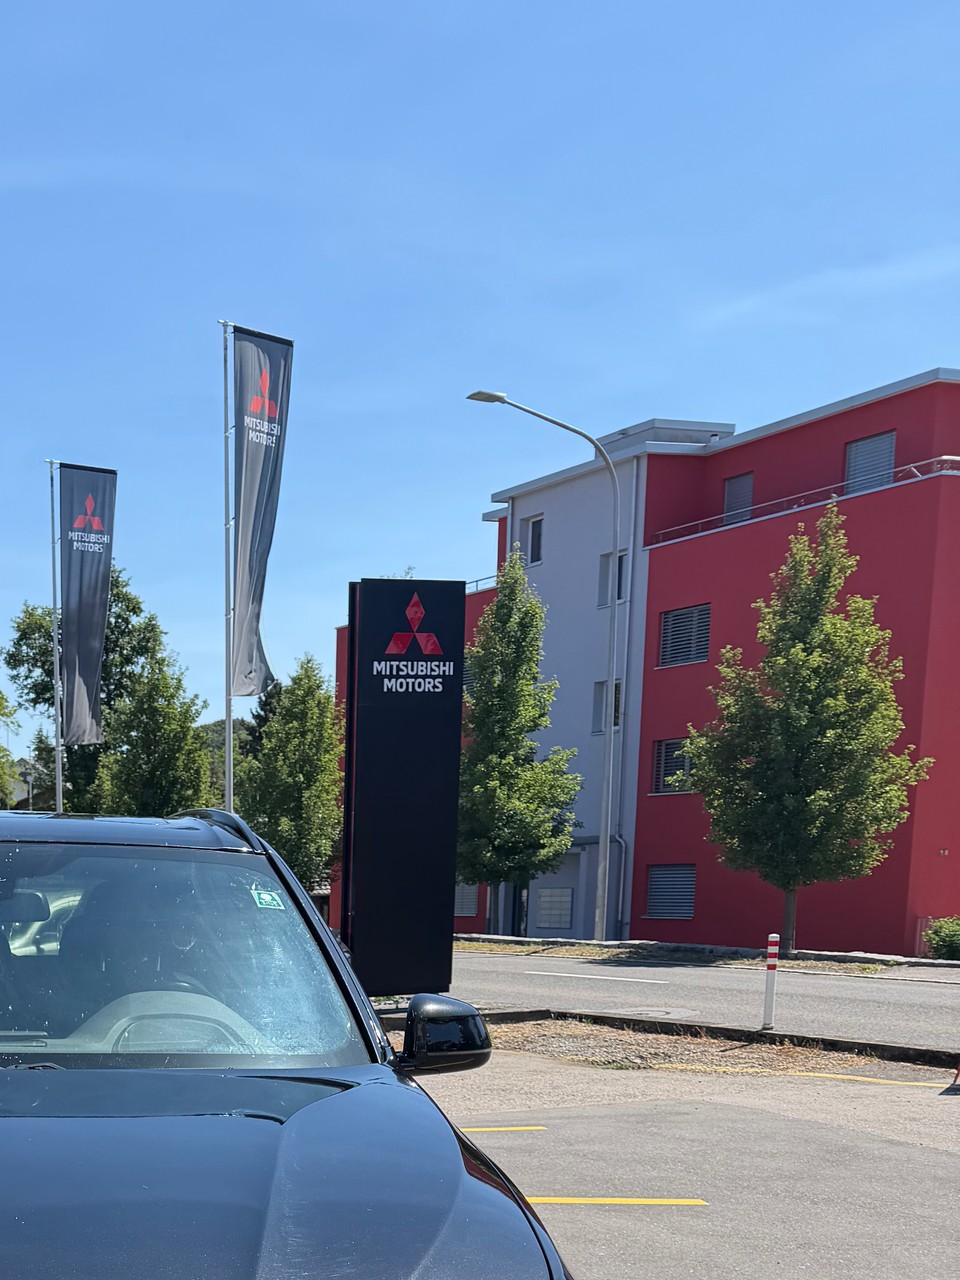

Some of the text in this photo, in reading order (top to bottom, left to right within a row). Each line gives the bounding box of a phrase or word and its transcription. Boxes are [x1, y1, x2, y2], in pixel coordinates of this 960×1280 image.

[68, 531, 110, 543] MITSUBISHI
[73, 541, 104, 552] MOTORS
[373, 661, 454, 676] MITSUBISHI
[383, 678, 443, 692] MOTORS
